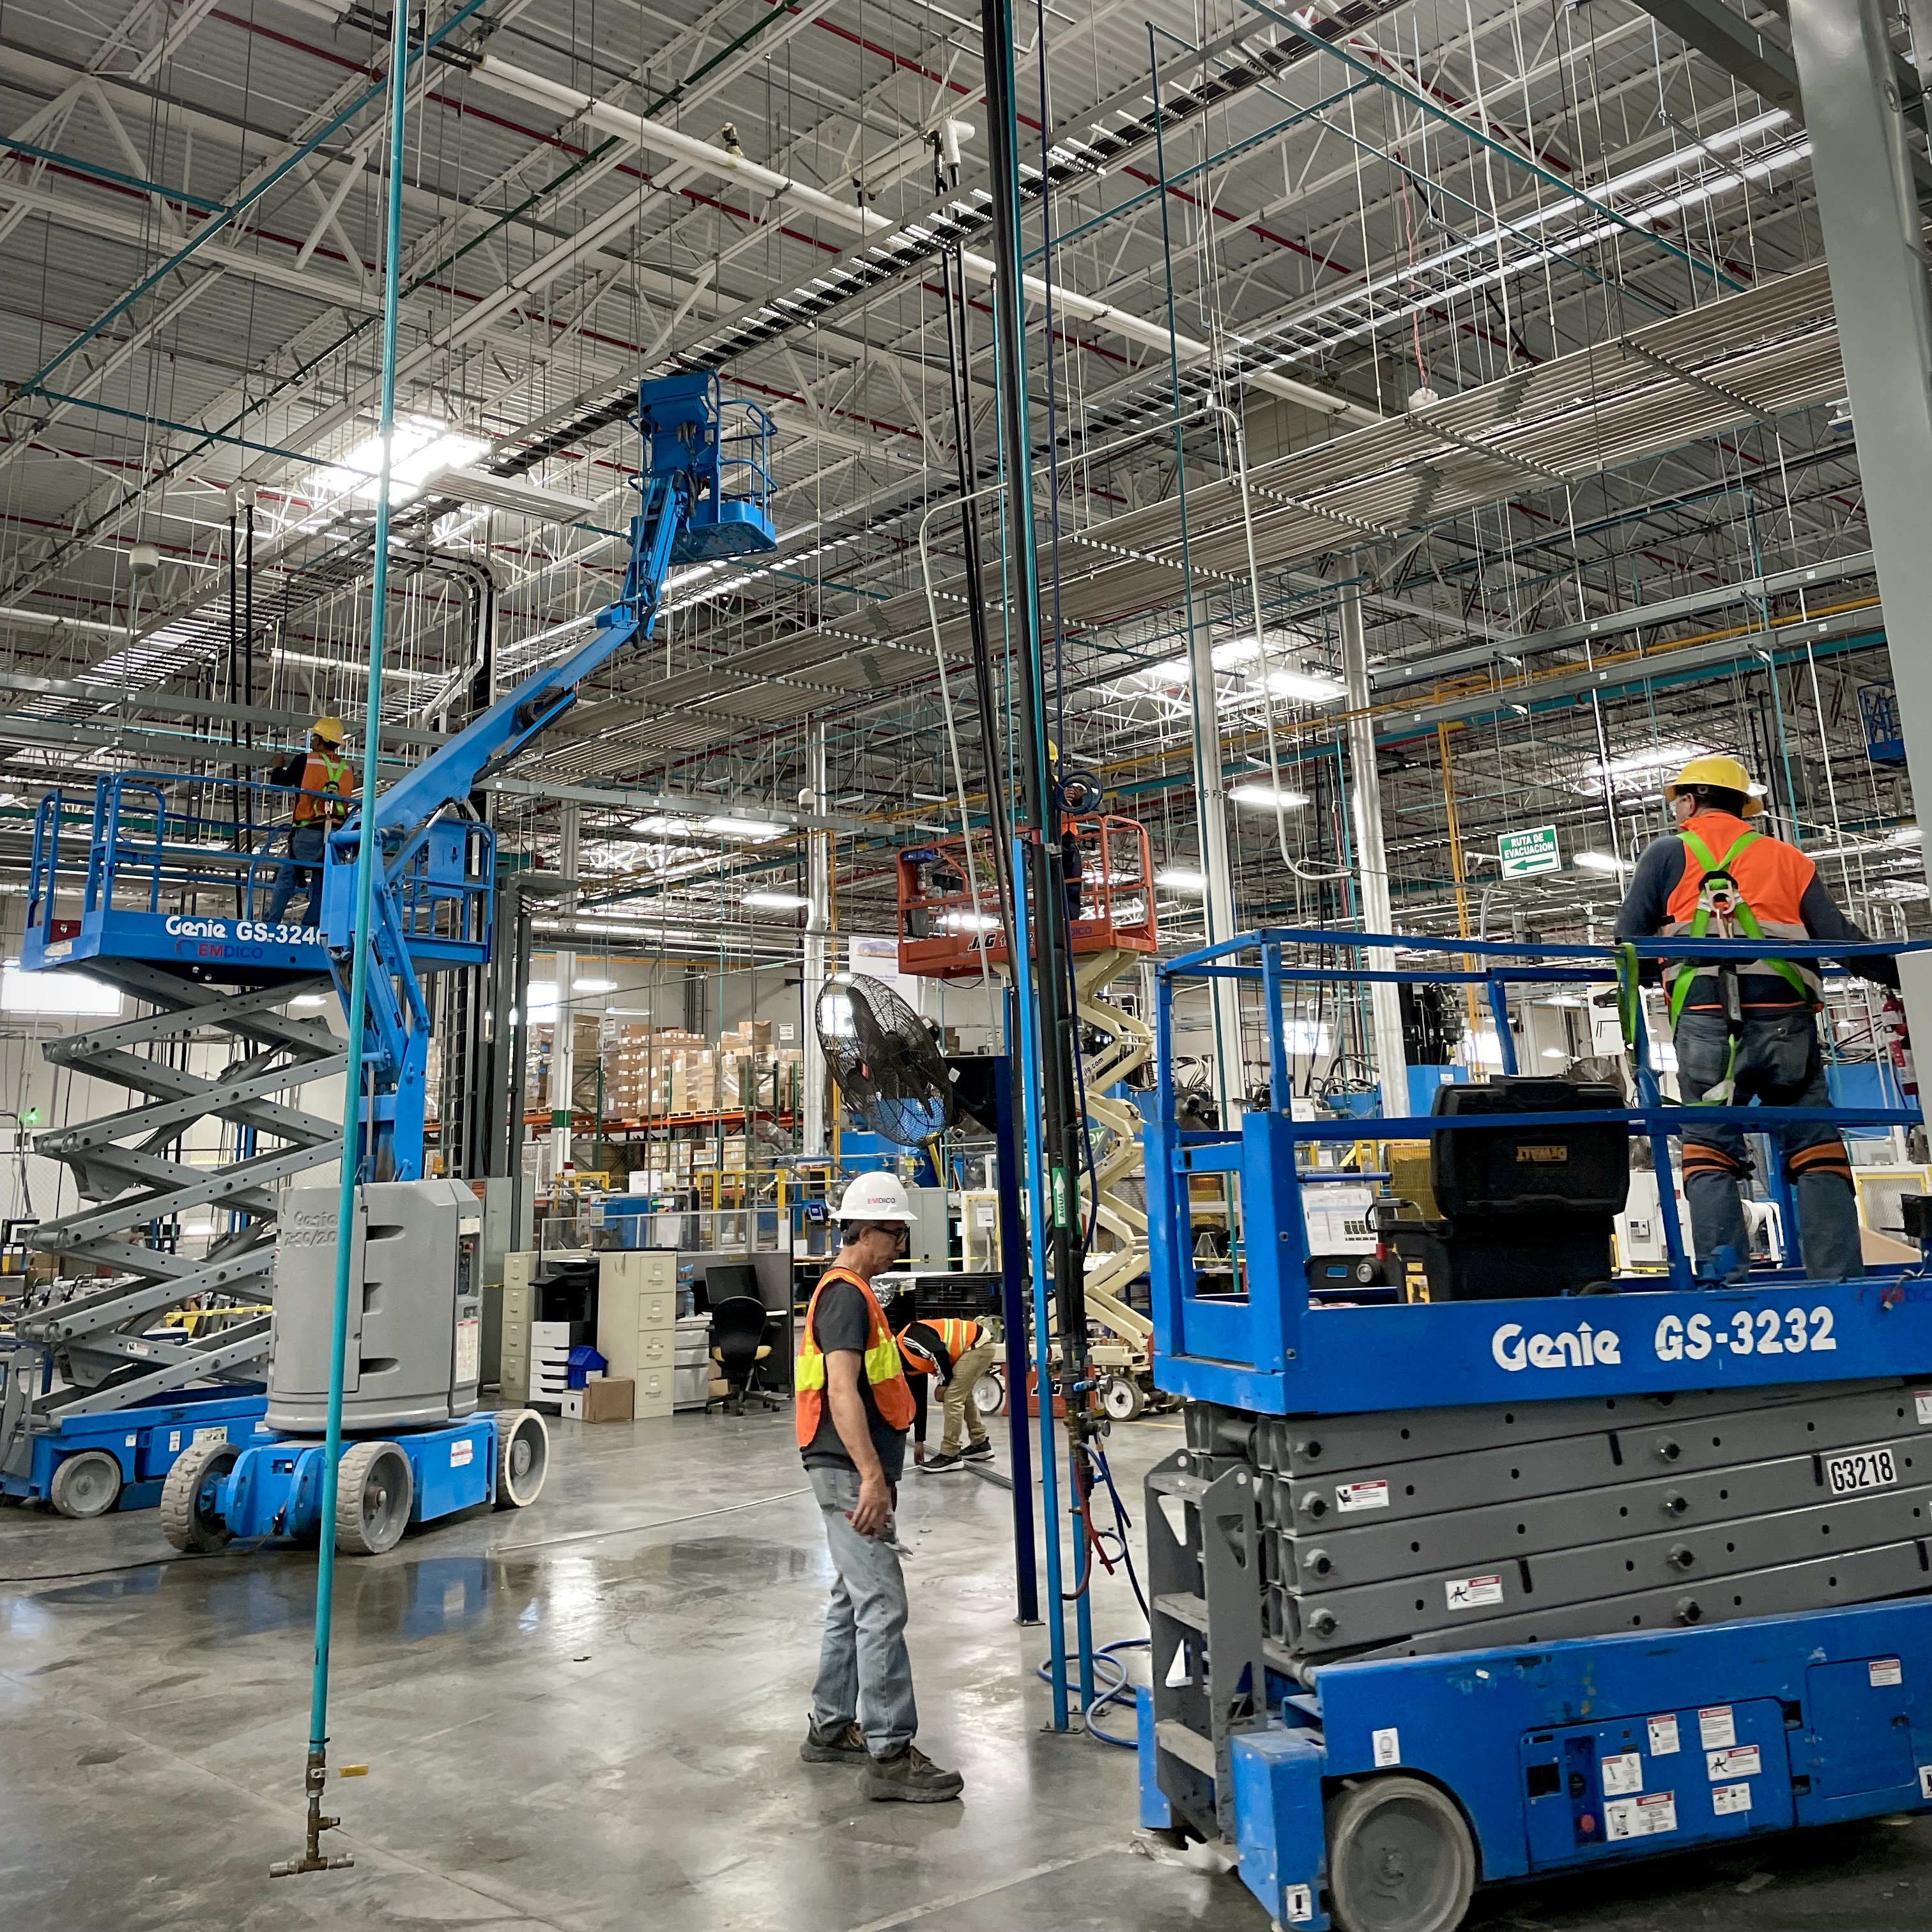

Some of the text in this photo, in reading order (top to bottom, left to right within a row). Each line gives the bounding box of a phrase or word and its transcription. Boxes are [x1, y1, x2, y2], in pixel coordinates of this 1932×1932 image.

[1511, 832, 1544, 848] RUTA DE
[1504, 841, 1554, 859] EVACUACION
[165, 916, 320, 946] Genie GS-324
[199, 943, 263, 959] EMDICO
[1517, 1148, 1567, 1161] DEWALT
[1492, 1306, 1837, 1372] Genie GS-3232
[1831, 1452, 1893, 1491] G3218
